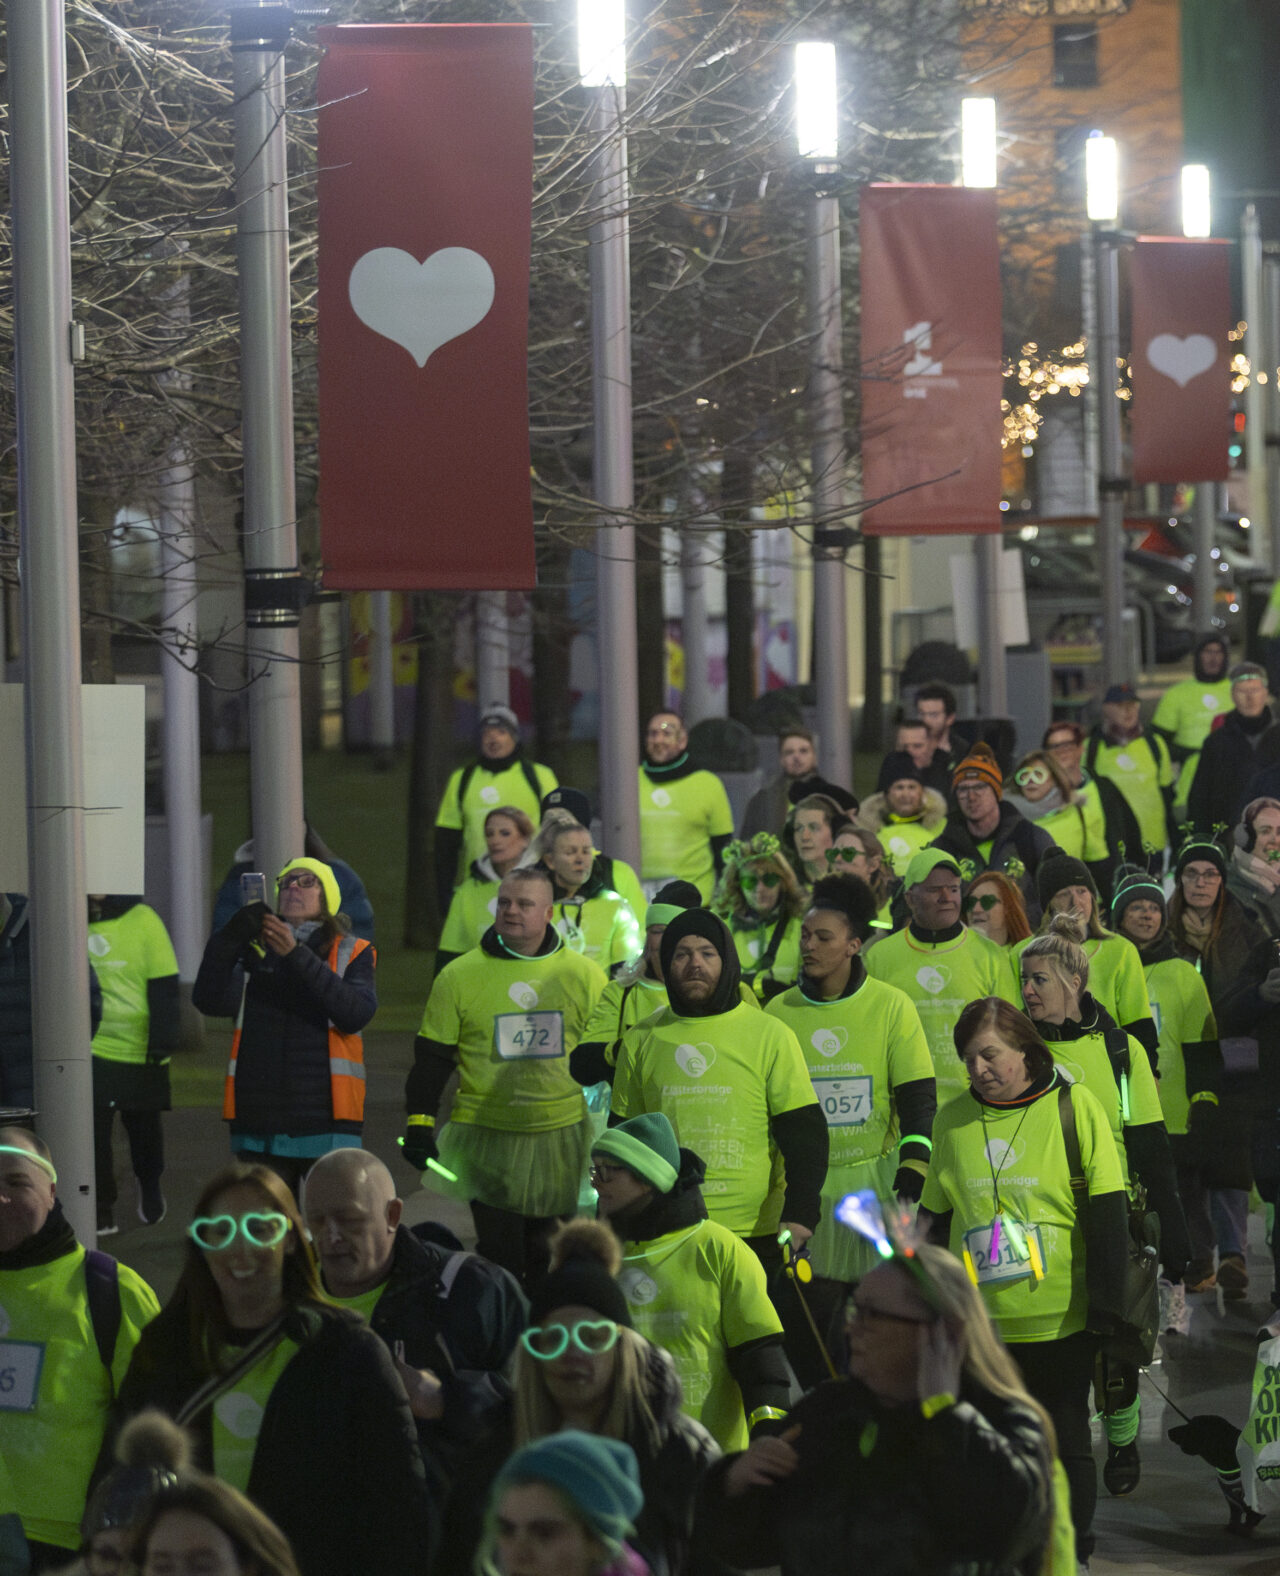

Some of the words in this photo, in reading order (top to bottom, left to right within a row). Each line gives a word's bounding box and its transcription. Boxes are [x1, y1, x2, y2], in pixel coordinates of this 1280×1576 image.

[512, 1028, 550, 1047] 472
[825, 1095, 864, 1115] 057
[0, 1367, 16, 1393] 6
